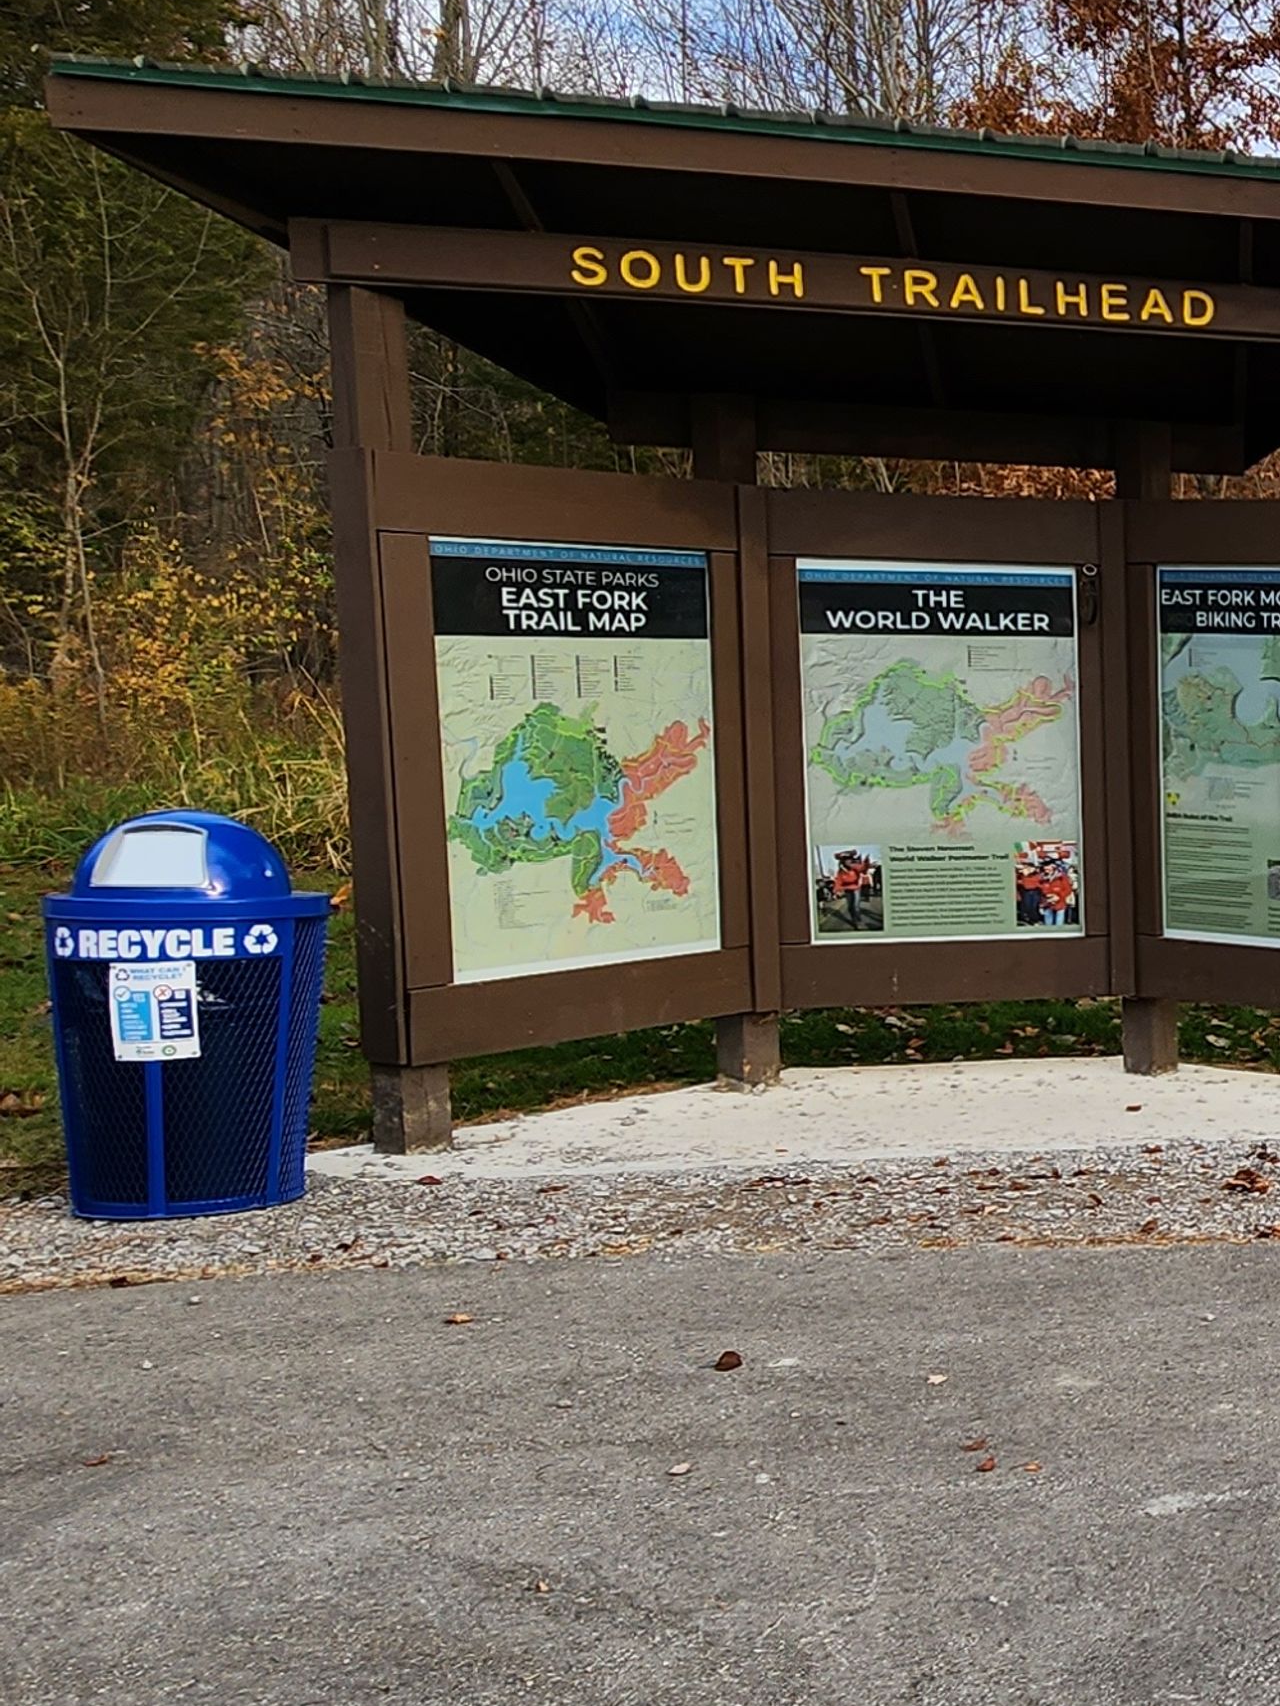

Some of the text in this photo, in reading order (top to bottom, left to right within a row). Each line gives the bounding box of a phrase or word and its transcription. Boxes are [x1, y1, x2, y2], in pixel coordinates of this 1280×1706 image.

[571, 245, 1216, 327] SOUTH TRAILHEAD
[434, 544, 700, 565] OHIO DEPARTMENT OF NATURAL RESOURCES
[485, 567, 660, 588] OHIO STATE PARKS
[501, 587, 649, 611] EAST FORK
[912, 590, 966, 609] THE
[1161, 589, 1203, 605] EAST
[1207, 590, 1256, 606] FORK
[502, 609, 647, 632] TRAIL MAP
[825, 610, 1050, 631] WORLD WALKER
[1195, 611, 1256, 628] BIKING
[78, 927, 235, 959] RECYCLE
